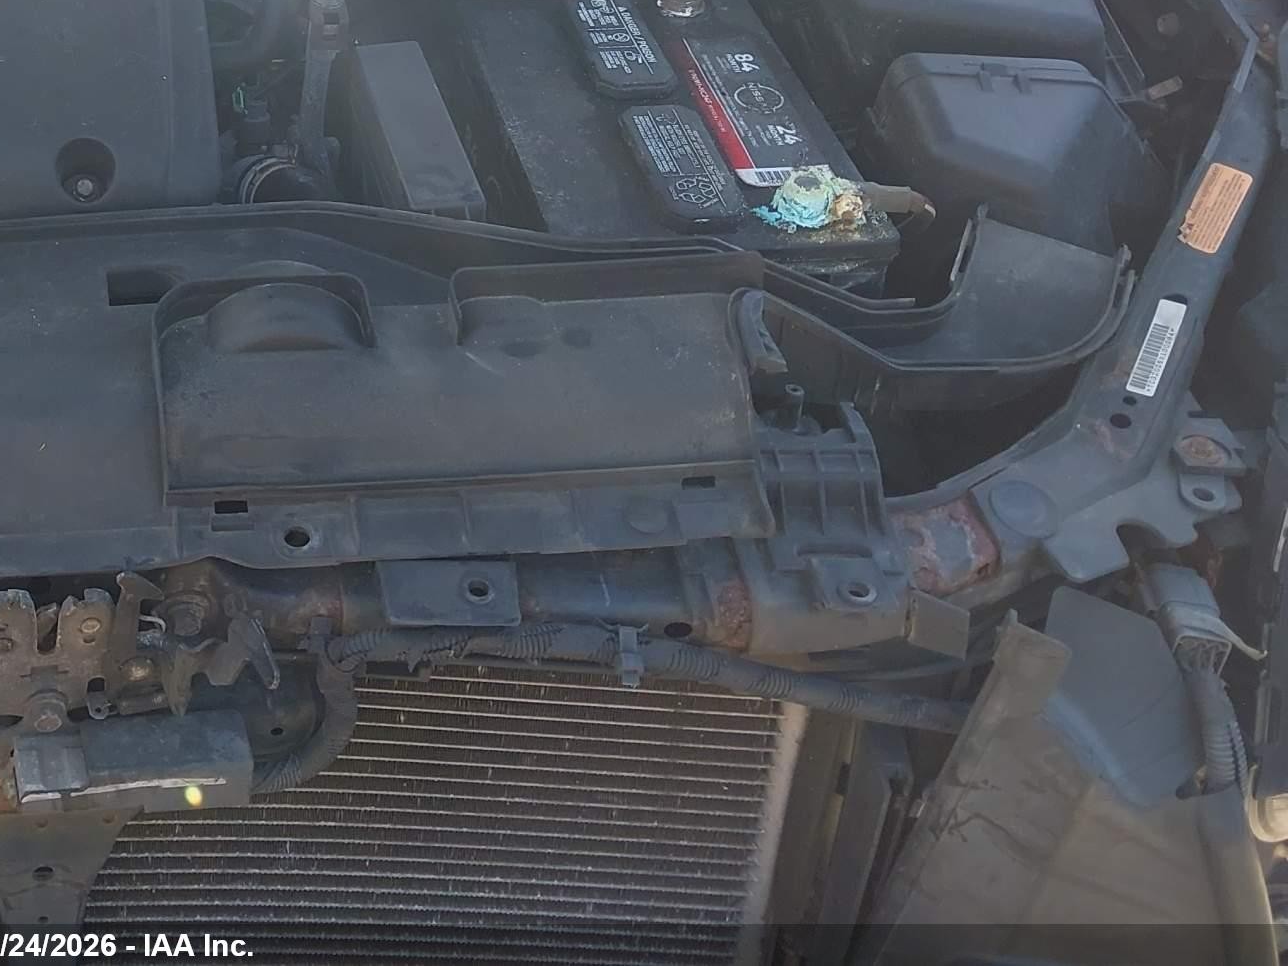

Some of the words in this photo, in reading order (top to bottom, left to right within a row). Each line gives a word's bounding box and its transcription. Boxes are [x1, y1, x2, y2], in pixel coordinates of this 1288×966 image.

[621, 11, 641, 38] DANGER
[637, 40, 657, 63] POISON
[726, 53, 742, 73] MONTH
[734, 53, 760, 72] 84
[767, 124, 785, 146] MONTH
[775, 124, 803, 145] 24
